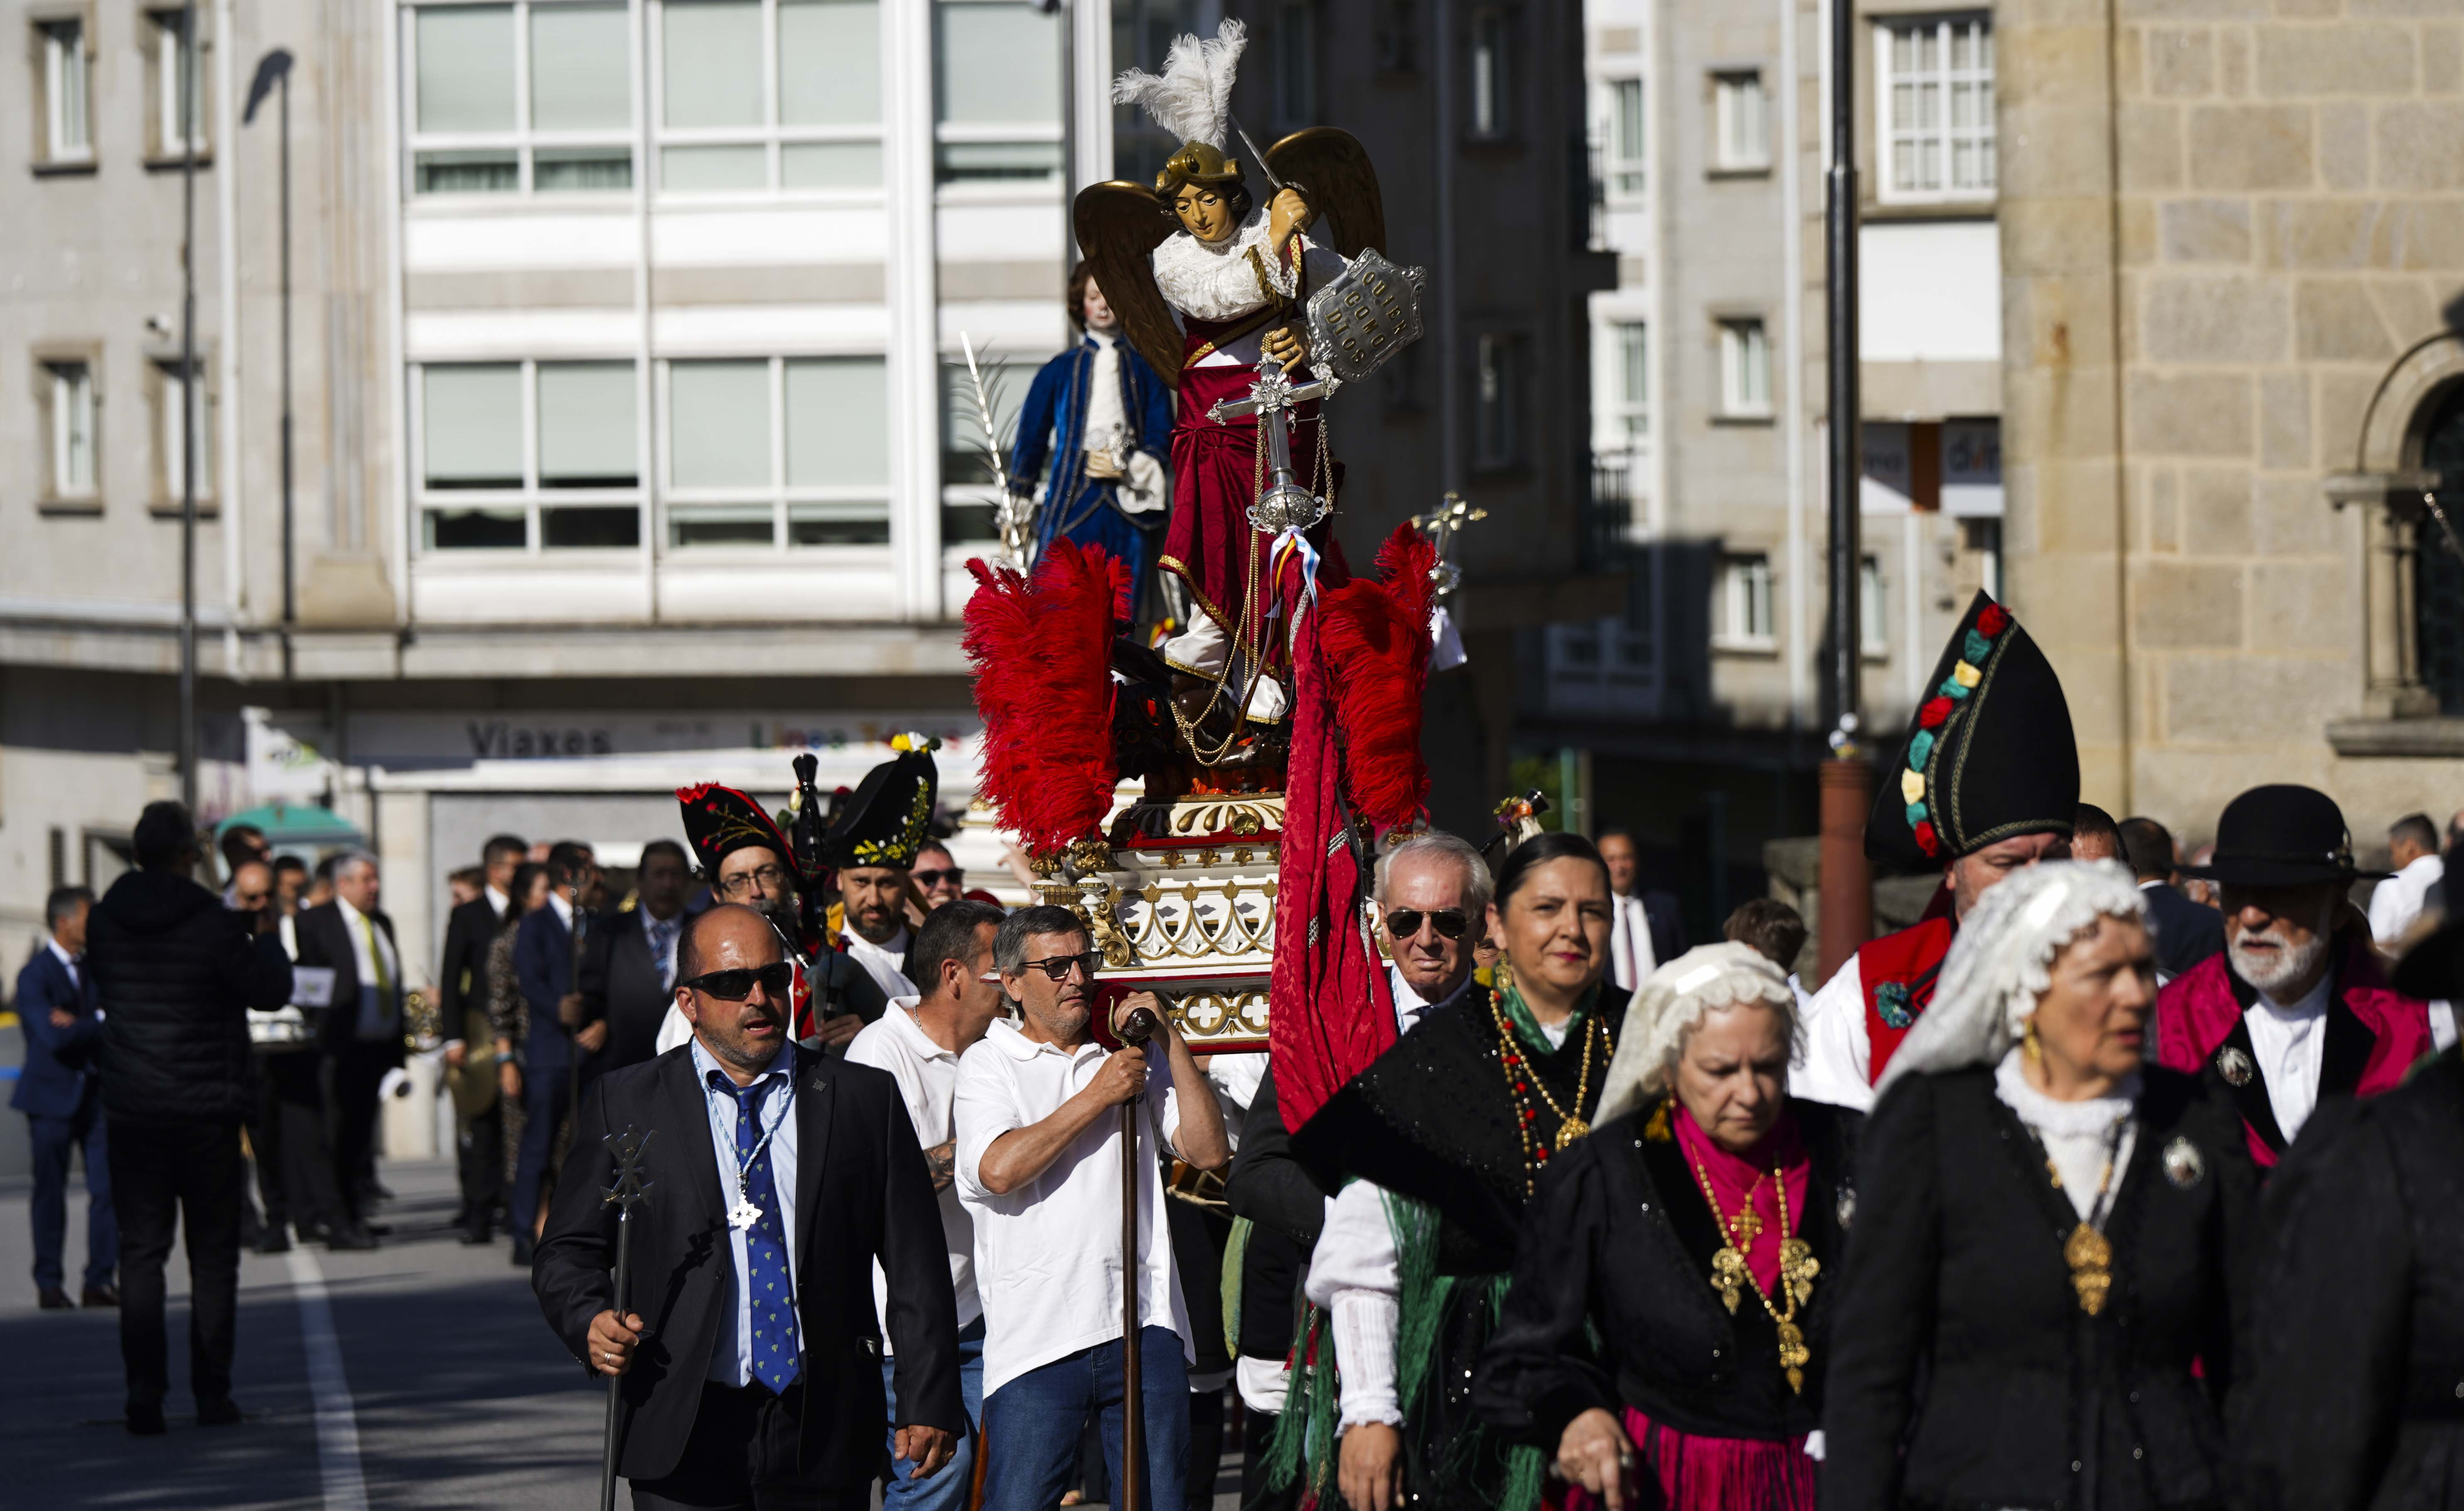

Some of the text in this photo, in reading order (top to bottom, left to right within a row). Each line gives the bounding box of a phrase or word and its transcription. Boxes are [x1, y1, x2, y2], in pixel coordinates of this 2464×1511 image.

[1344, 292, 1385, 347] COMO
[1362, 272, 1407, 335] QUIEN
[1325, 308, 1366, 363] DIOS
[465, 719, 614, 754] Viaxes
